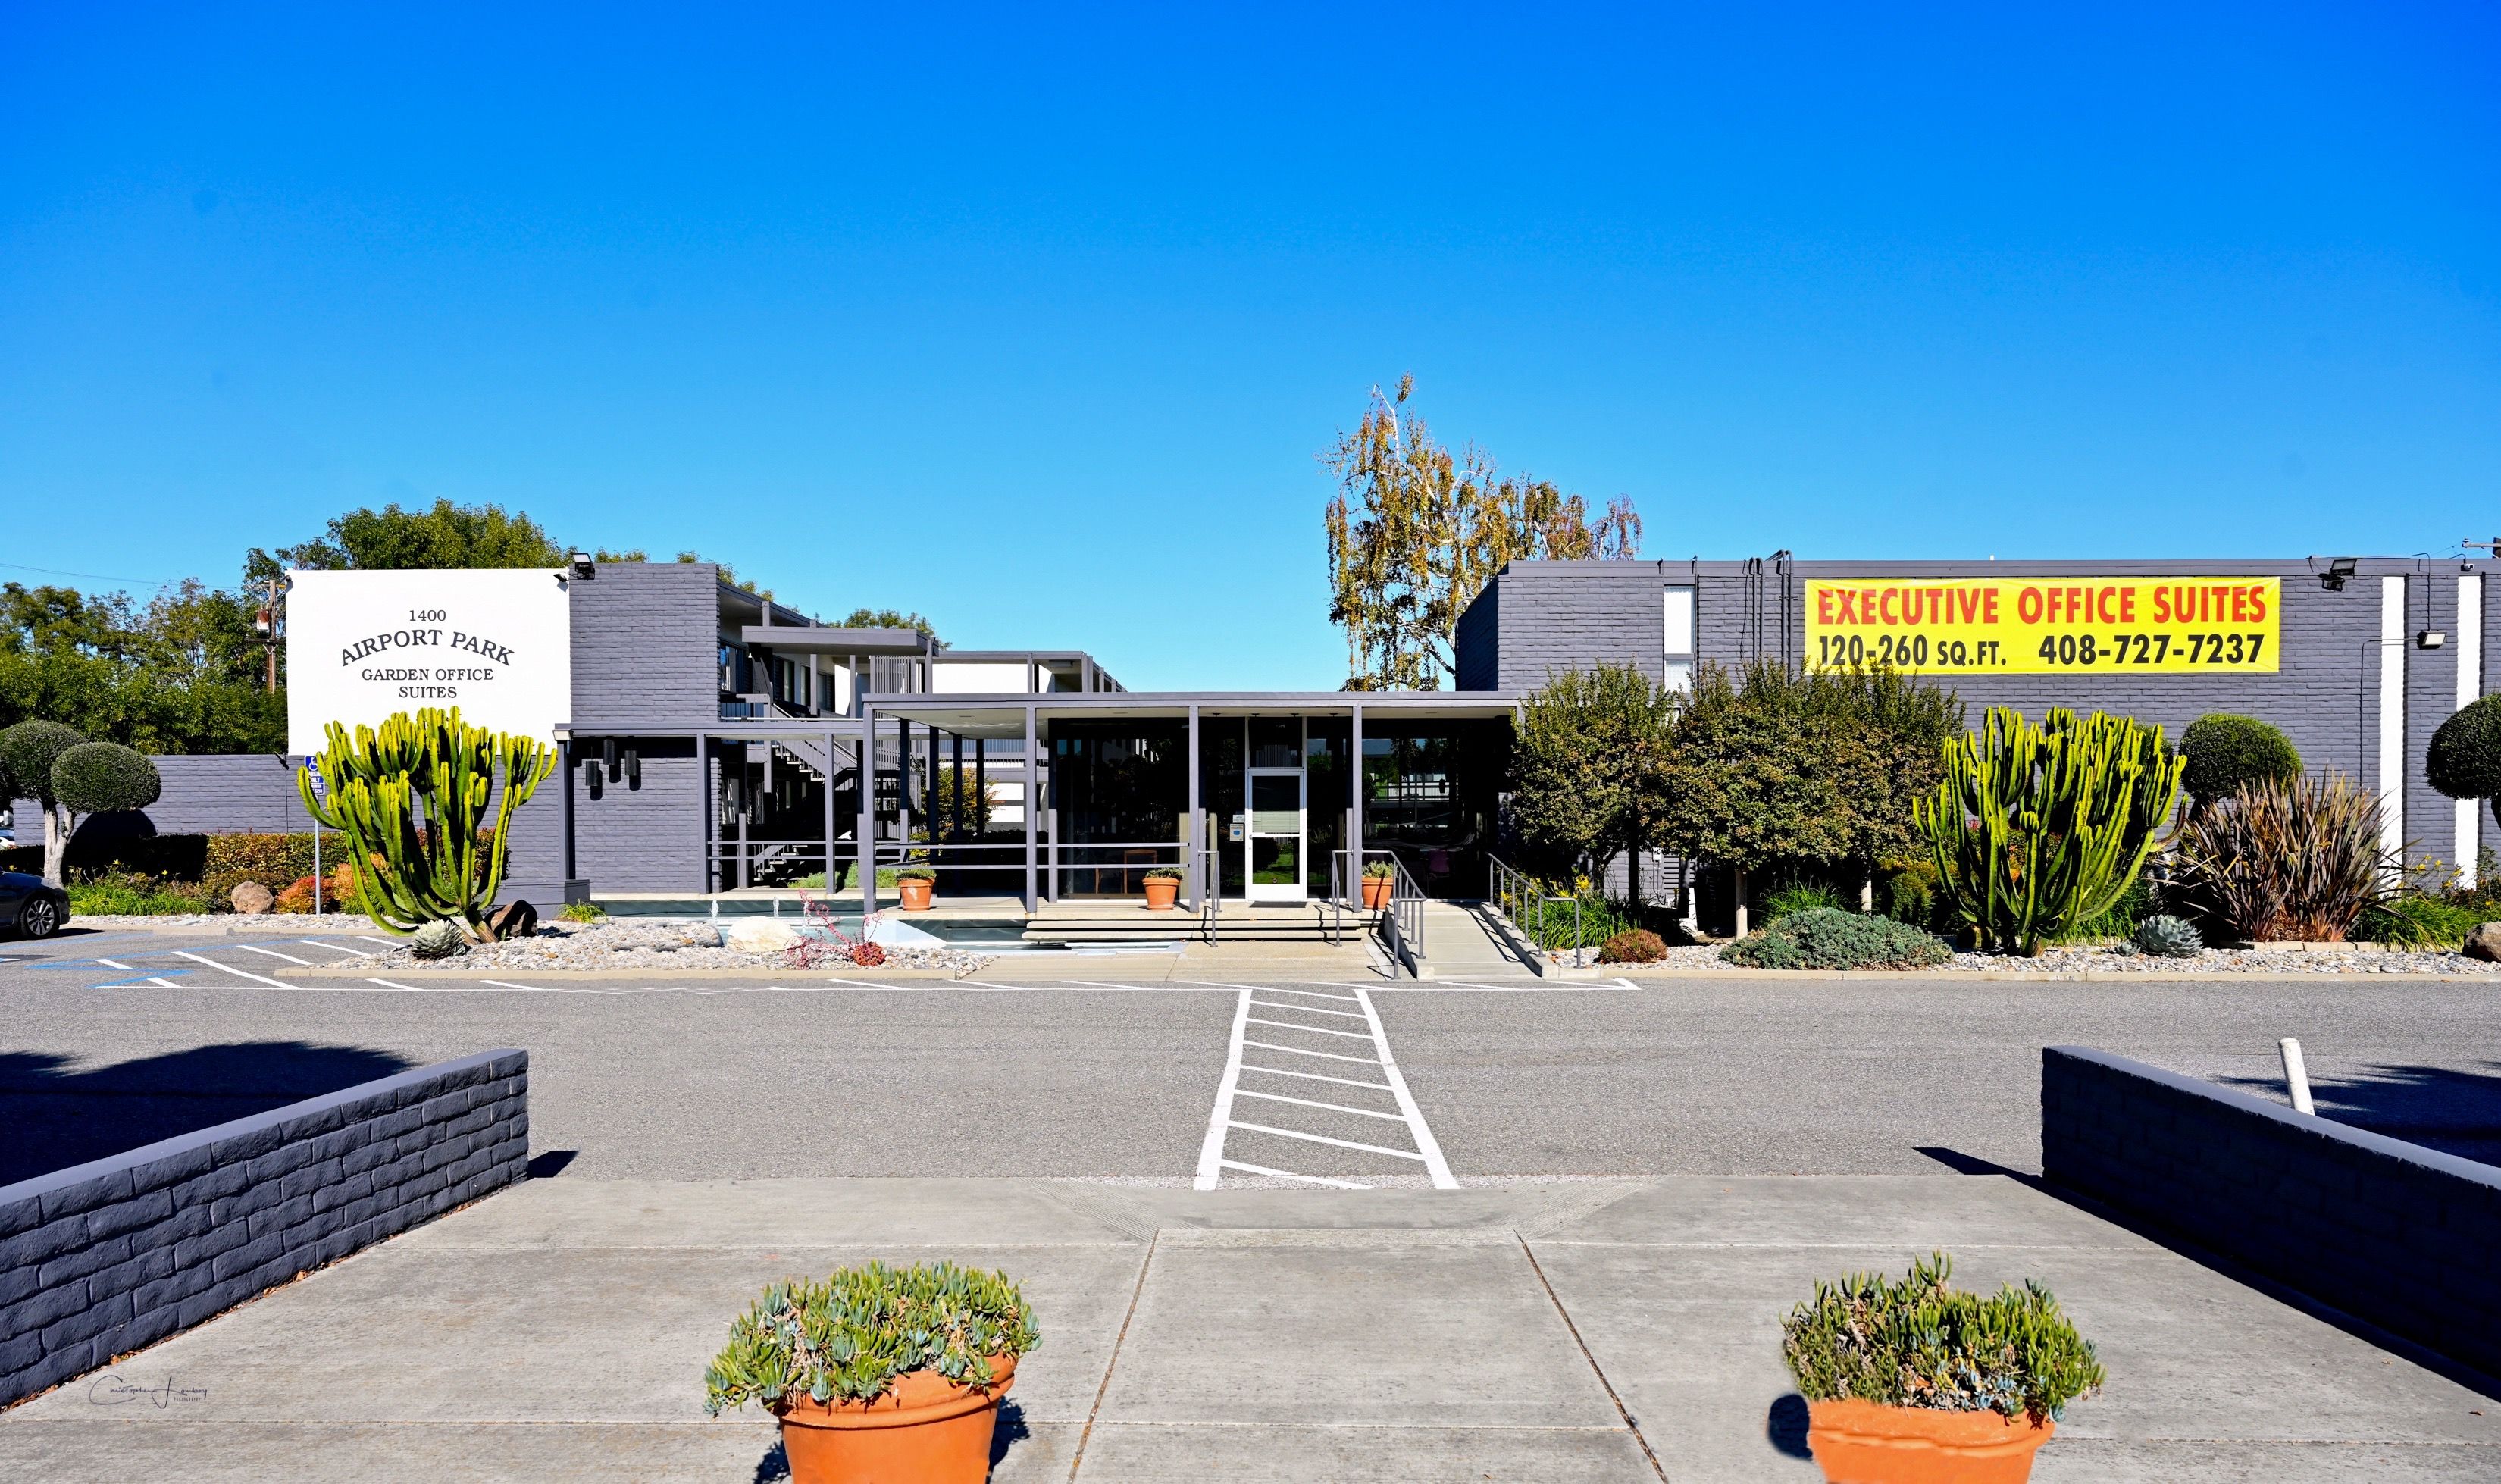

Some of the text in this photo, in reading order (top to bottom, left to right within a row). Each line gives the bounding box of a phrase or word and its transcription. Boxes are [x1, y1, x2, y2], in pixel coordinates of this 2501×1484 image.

[409, 609, 446, 621] 1400
[1818, 586, 2266, 625] EXECUTIVE OFFICE SUITES
[342, 629, 515, 667] AIRPORT PARK
[1818, 634, 2265, 667] 120-260 SQ.FT. 408-727-7237
[362, 668, 494, 681] GARDEN OFFICE
[398, 686, 457, 699] SUITES
